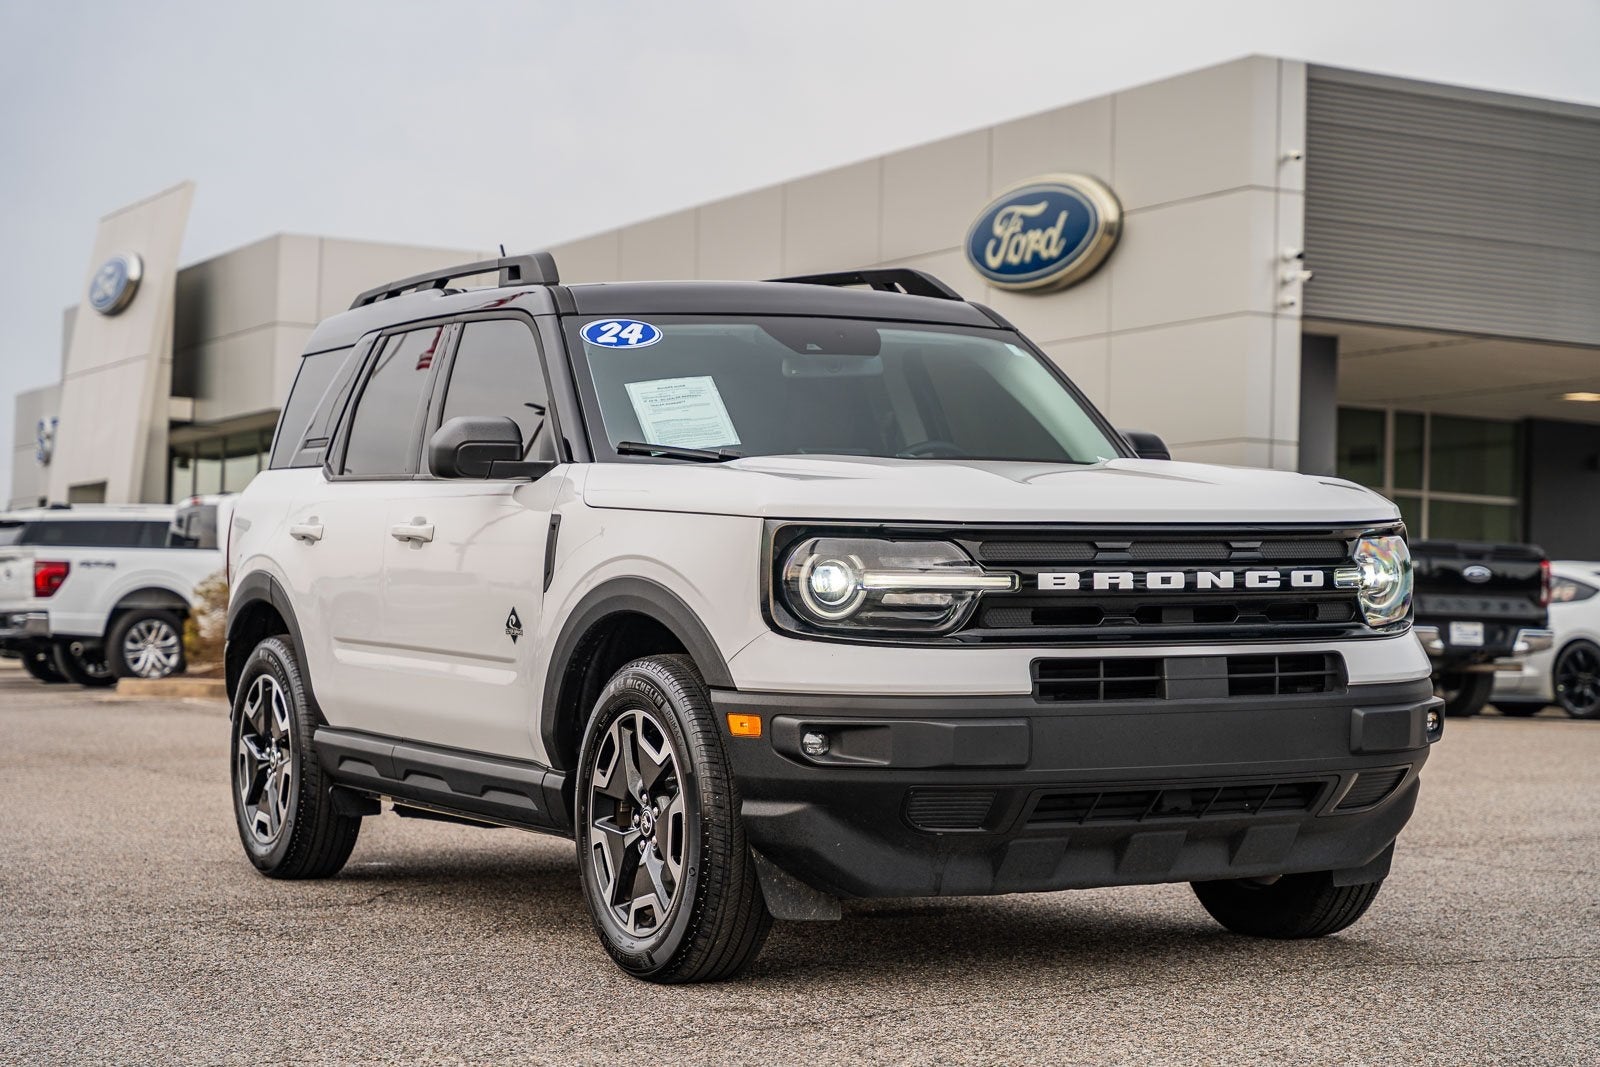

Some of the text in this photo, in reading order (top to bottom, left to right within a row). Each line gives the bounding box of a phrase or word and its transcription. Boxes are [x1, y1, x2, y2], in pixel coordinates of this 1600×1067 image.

[985, 200, 1069, 269] Ford
[596, 322, 643, 345] 24
[1037, 570, 1324, 590] BRONCO
[625, 679, 664, 707] MICHELIN
